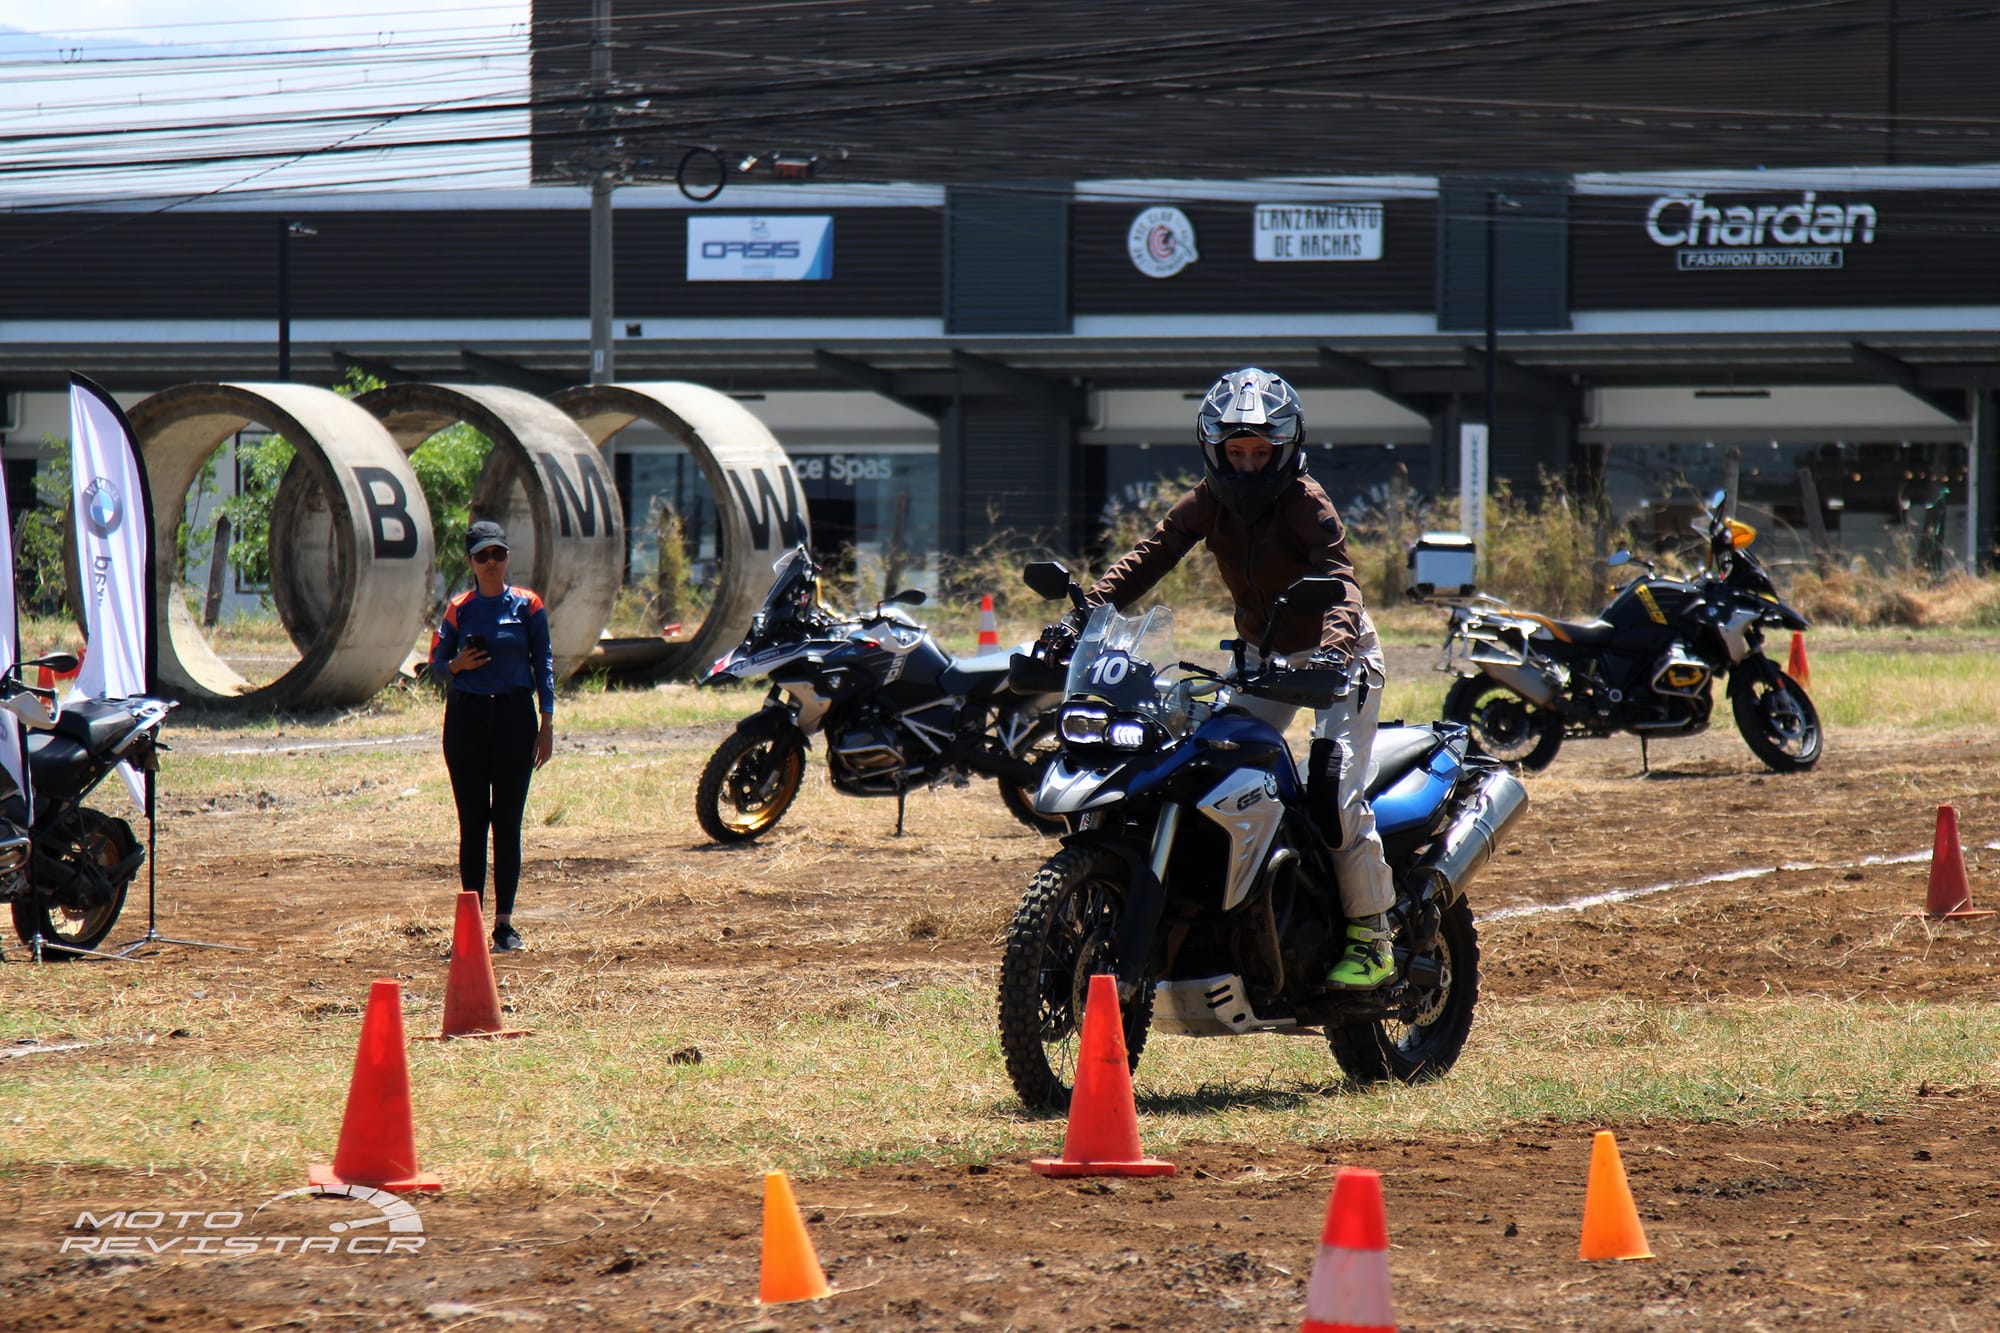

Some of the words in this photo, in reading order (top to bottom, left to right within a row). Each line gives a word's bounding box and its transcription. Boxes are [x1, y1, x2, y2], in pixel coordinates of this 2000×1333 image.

[1259, 207, 1379, 230] LANZAMIENTO
[1647, 191, 1877, 246] Chardan
[702, 240, 800, 259] OASIS
[1273, 233, 1294, 257] DE
[1300, 233, 1362, 257] HACHAS
[1687, 253, 1753, 267] FASHION
[1756, 252, 1834, 266] BOUTIQUE
[829, 454, 893, 486] Spas
[352, 466, 418, 559] B
[536, 452, 614, 538] M
[726, 464, 803, 551] W
[1091, 655, 1129, 685] 10
[1237, 786, 1263, 811] GS
